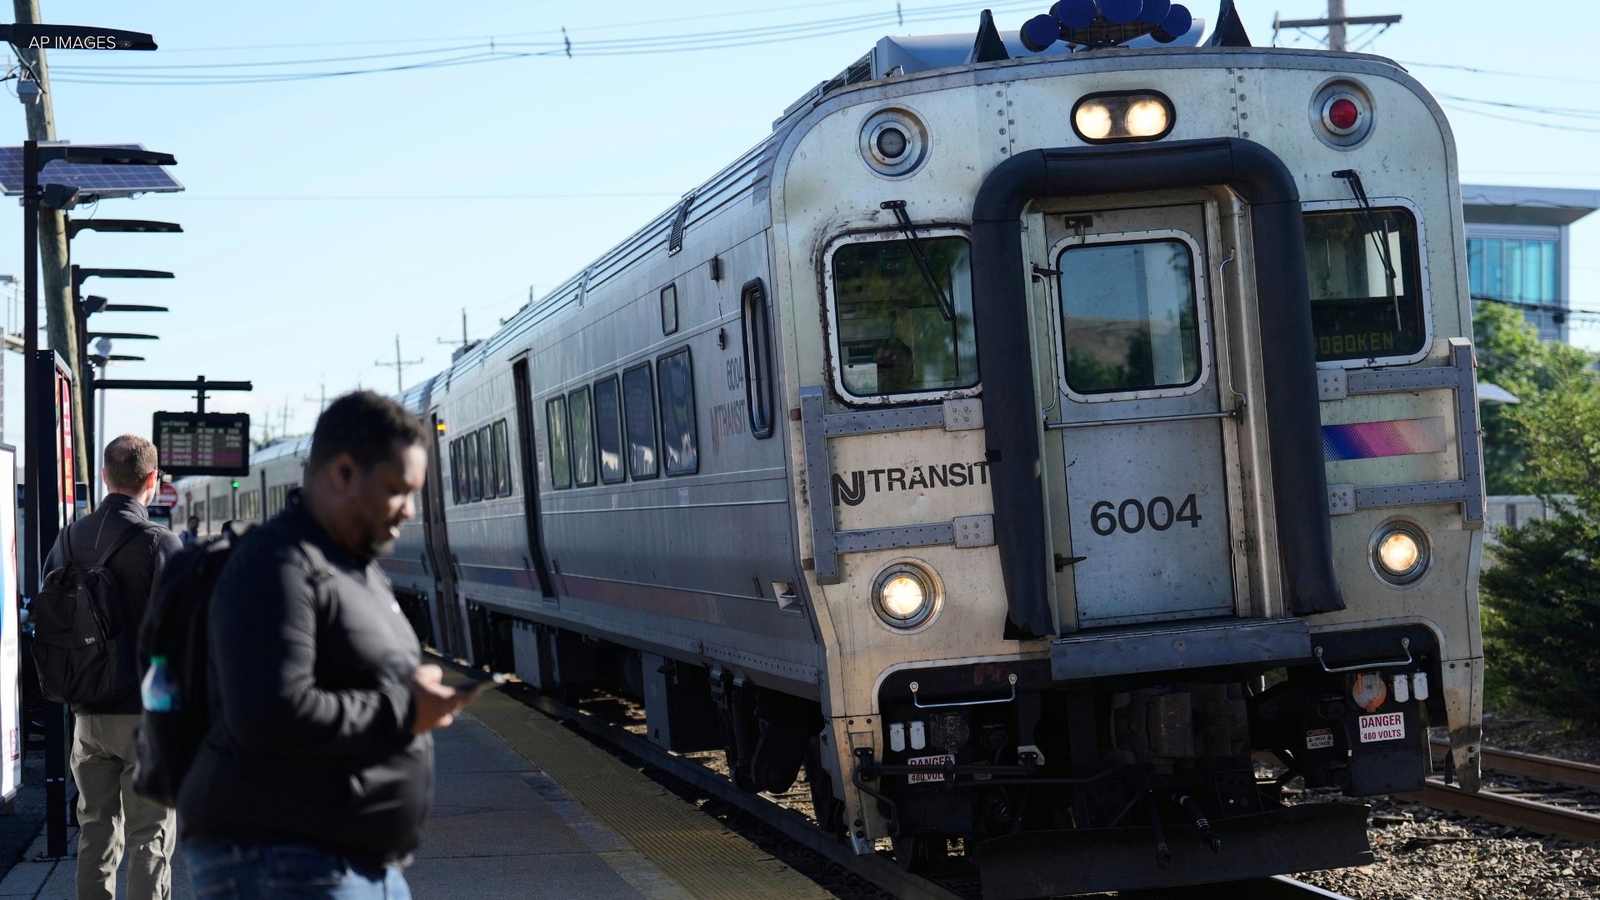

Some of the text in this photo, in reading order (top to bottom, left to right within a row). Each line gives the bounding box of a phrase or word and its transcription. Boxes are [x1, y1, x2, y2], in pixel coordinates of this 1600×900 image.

[831, 461, 989, 507] NJ TRANSIT
[1090, 493, 1202, 536] 6004
[1361, 714, 1401, 729] DANGER
[1363, 729, 1401, 741] 480 VOLTS
